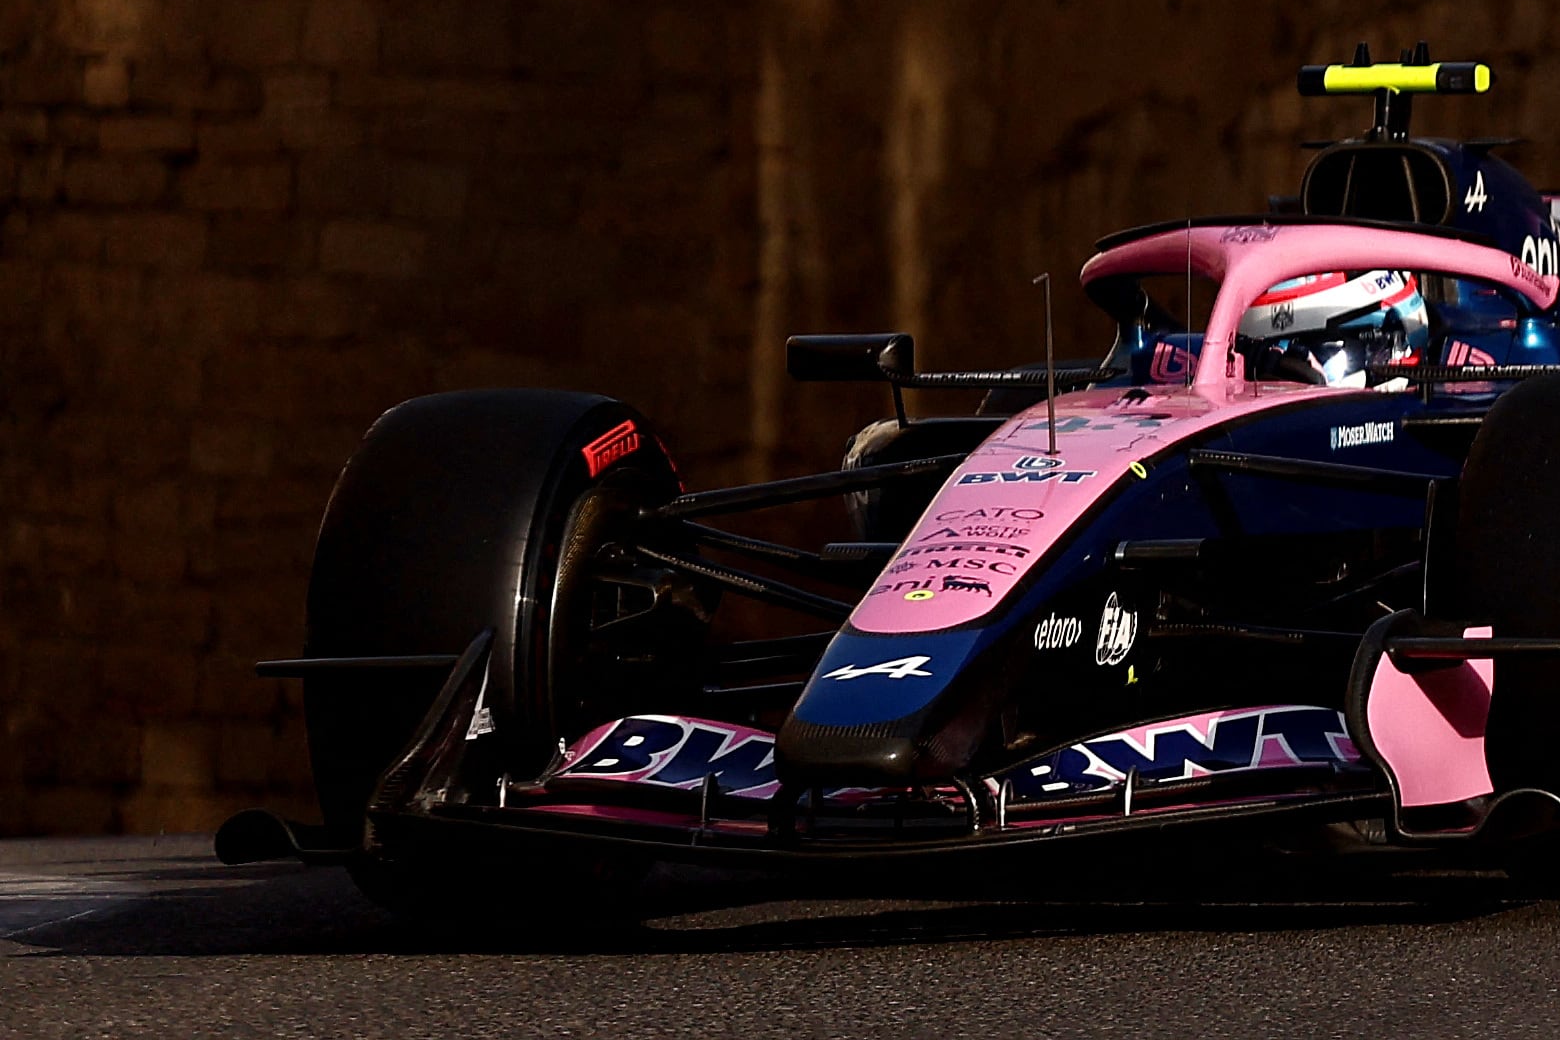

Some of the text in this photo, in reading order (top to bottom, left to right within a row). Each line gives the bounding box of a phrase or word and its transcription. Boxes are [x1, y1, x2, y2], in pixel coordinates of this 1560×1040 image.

[581, 419, 640, 479] PIRELLI
[955, 470, 1096, 486] BWT
[936, 508, 1044, 521] CATO
[926, 558, 1017, 576] MSC
[869, 575, 936, 596] eni
[1098, 606, 1131, 650] FIA
[562, 716, 783, 798] BW
[990, 707, 1349, 796] BWT
